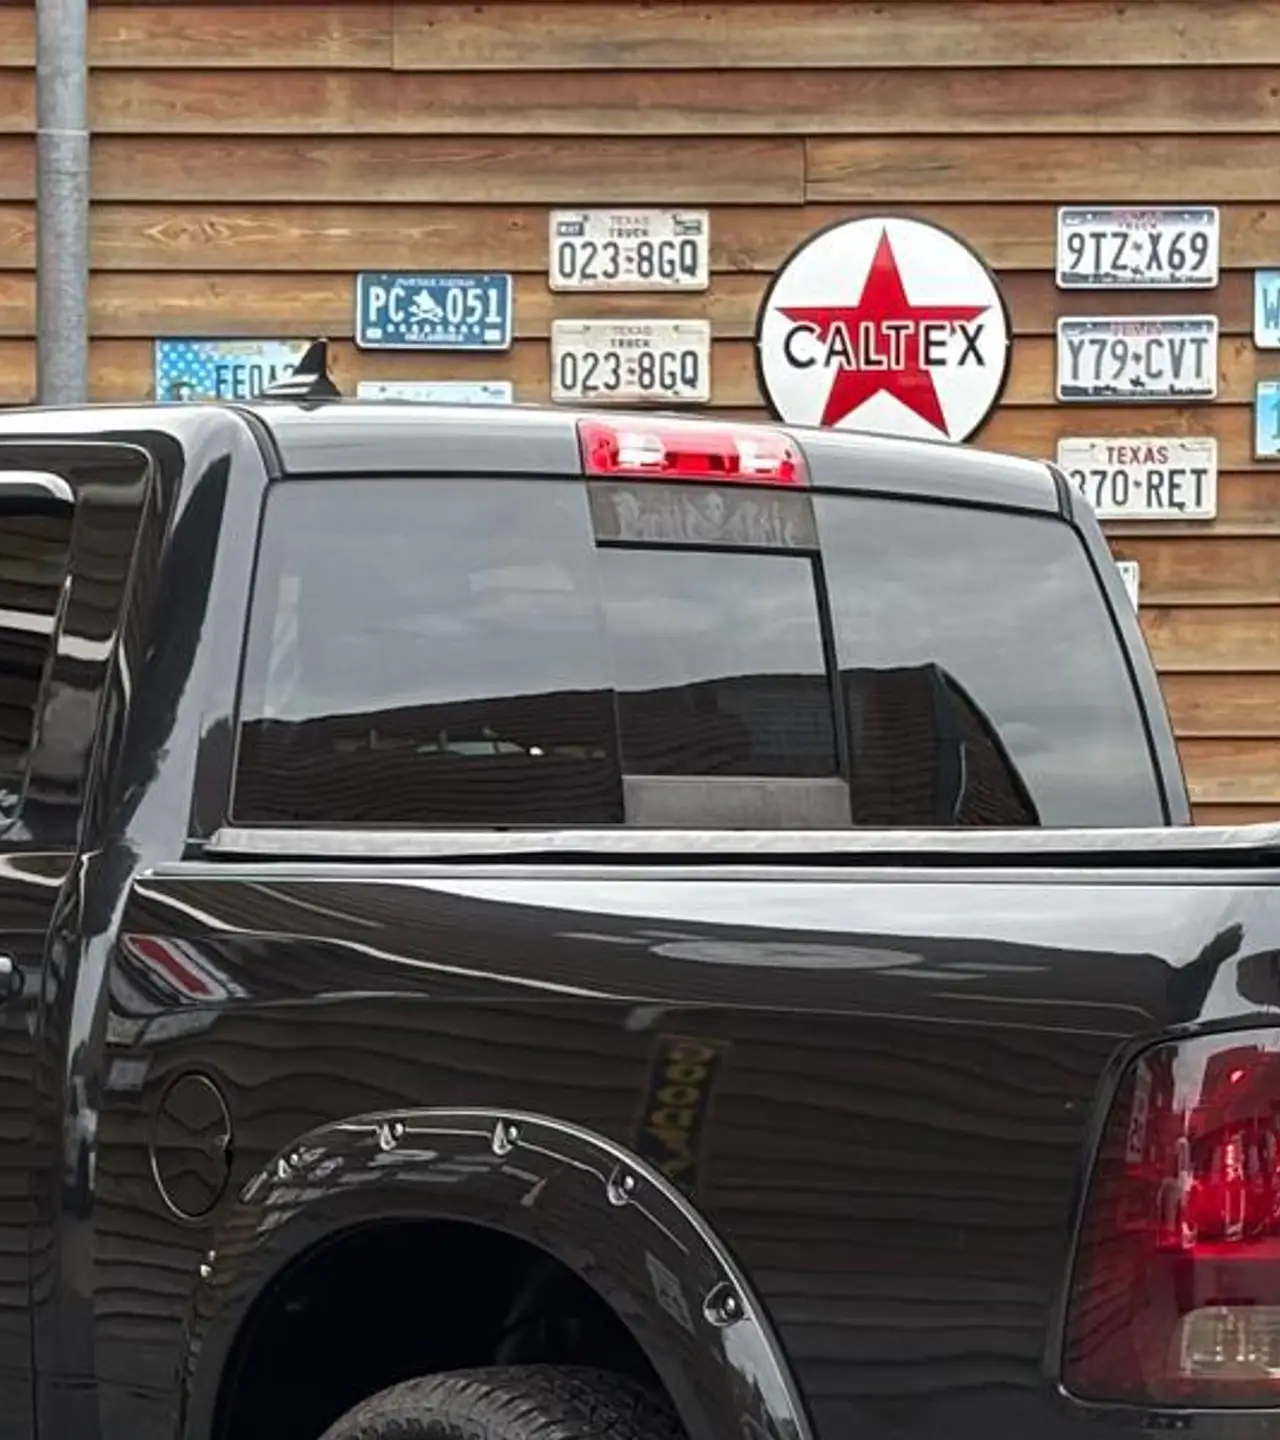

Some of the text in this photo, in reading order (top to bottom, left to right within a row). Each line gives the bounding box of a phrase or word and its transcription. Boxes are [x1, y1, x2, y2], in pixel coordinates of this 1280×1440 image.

[558, 239, 699, 280] 023 8GQ
[1067, 231, 1209, 271] 9TZ X69
[369, 286, 502, 324] PC 051
[783, 323, 986, 370] CALTEX
[1067, 338, 1209, 381] Y79 CVT
[560, 350, 699, 391] 023 8GQ
[1106, 446, 1170, 465] TEXAS
[1146, 468, 1208, 508] RET
